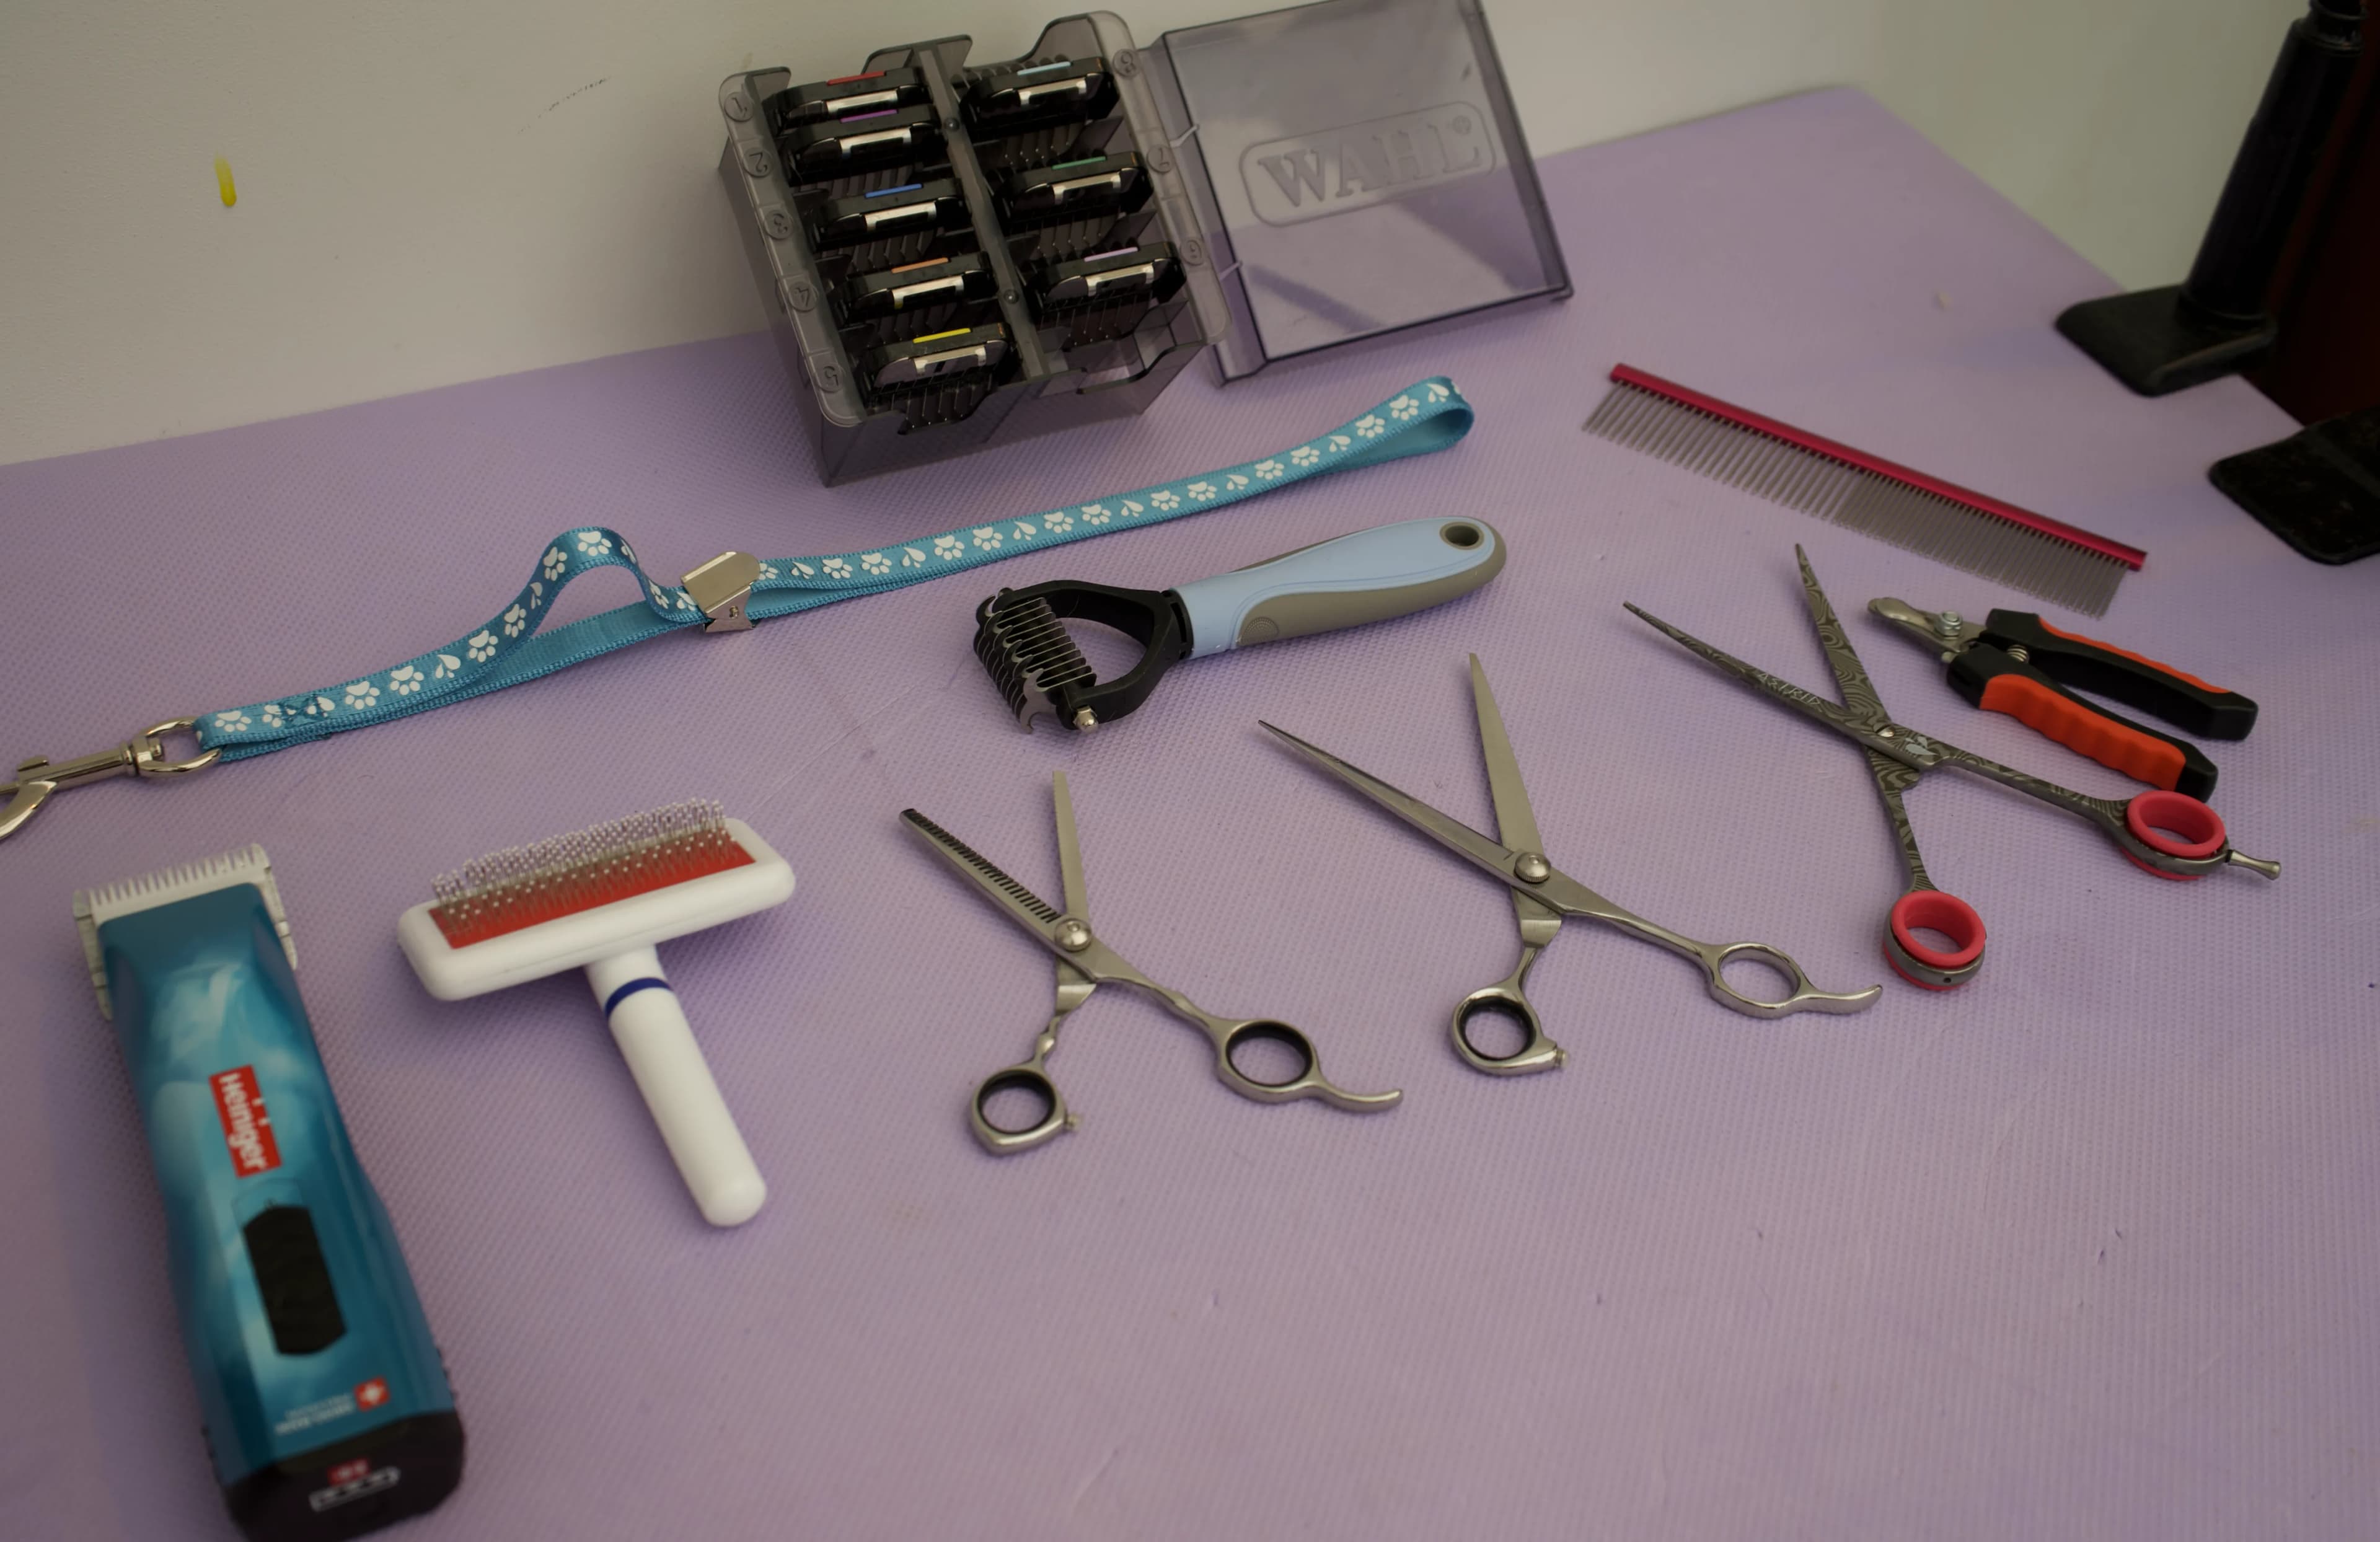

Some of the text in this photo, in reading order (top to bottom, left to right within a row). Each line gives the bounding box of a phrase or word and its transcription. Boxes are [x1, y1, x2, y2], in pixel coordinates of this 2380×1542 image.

[731, 98, 747, 117] 1
[749, 152, 769, 172] 2
[1257, 124, 1483, 207] WAHL
[774, 213, 788, 234] 3
[794, 286, 809, 307] 4
[824, 366, 839, 387] 5
[219, 1072, 270, 1171] Heiniger
